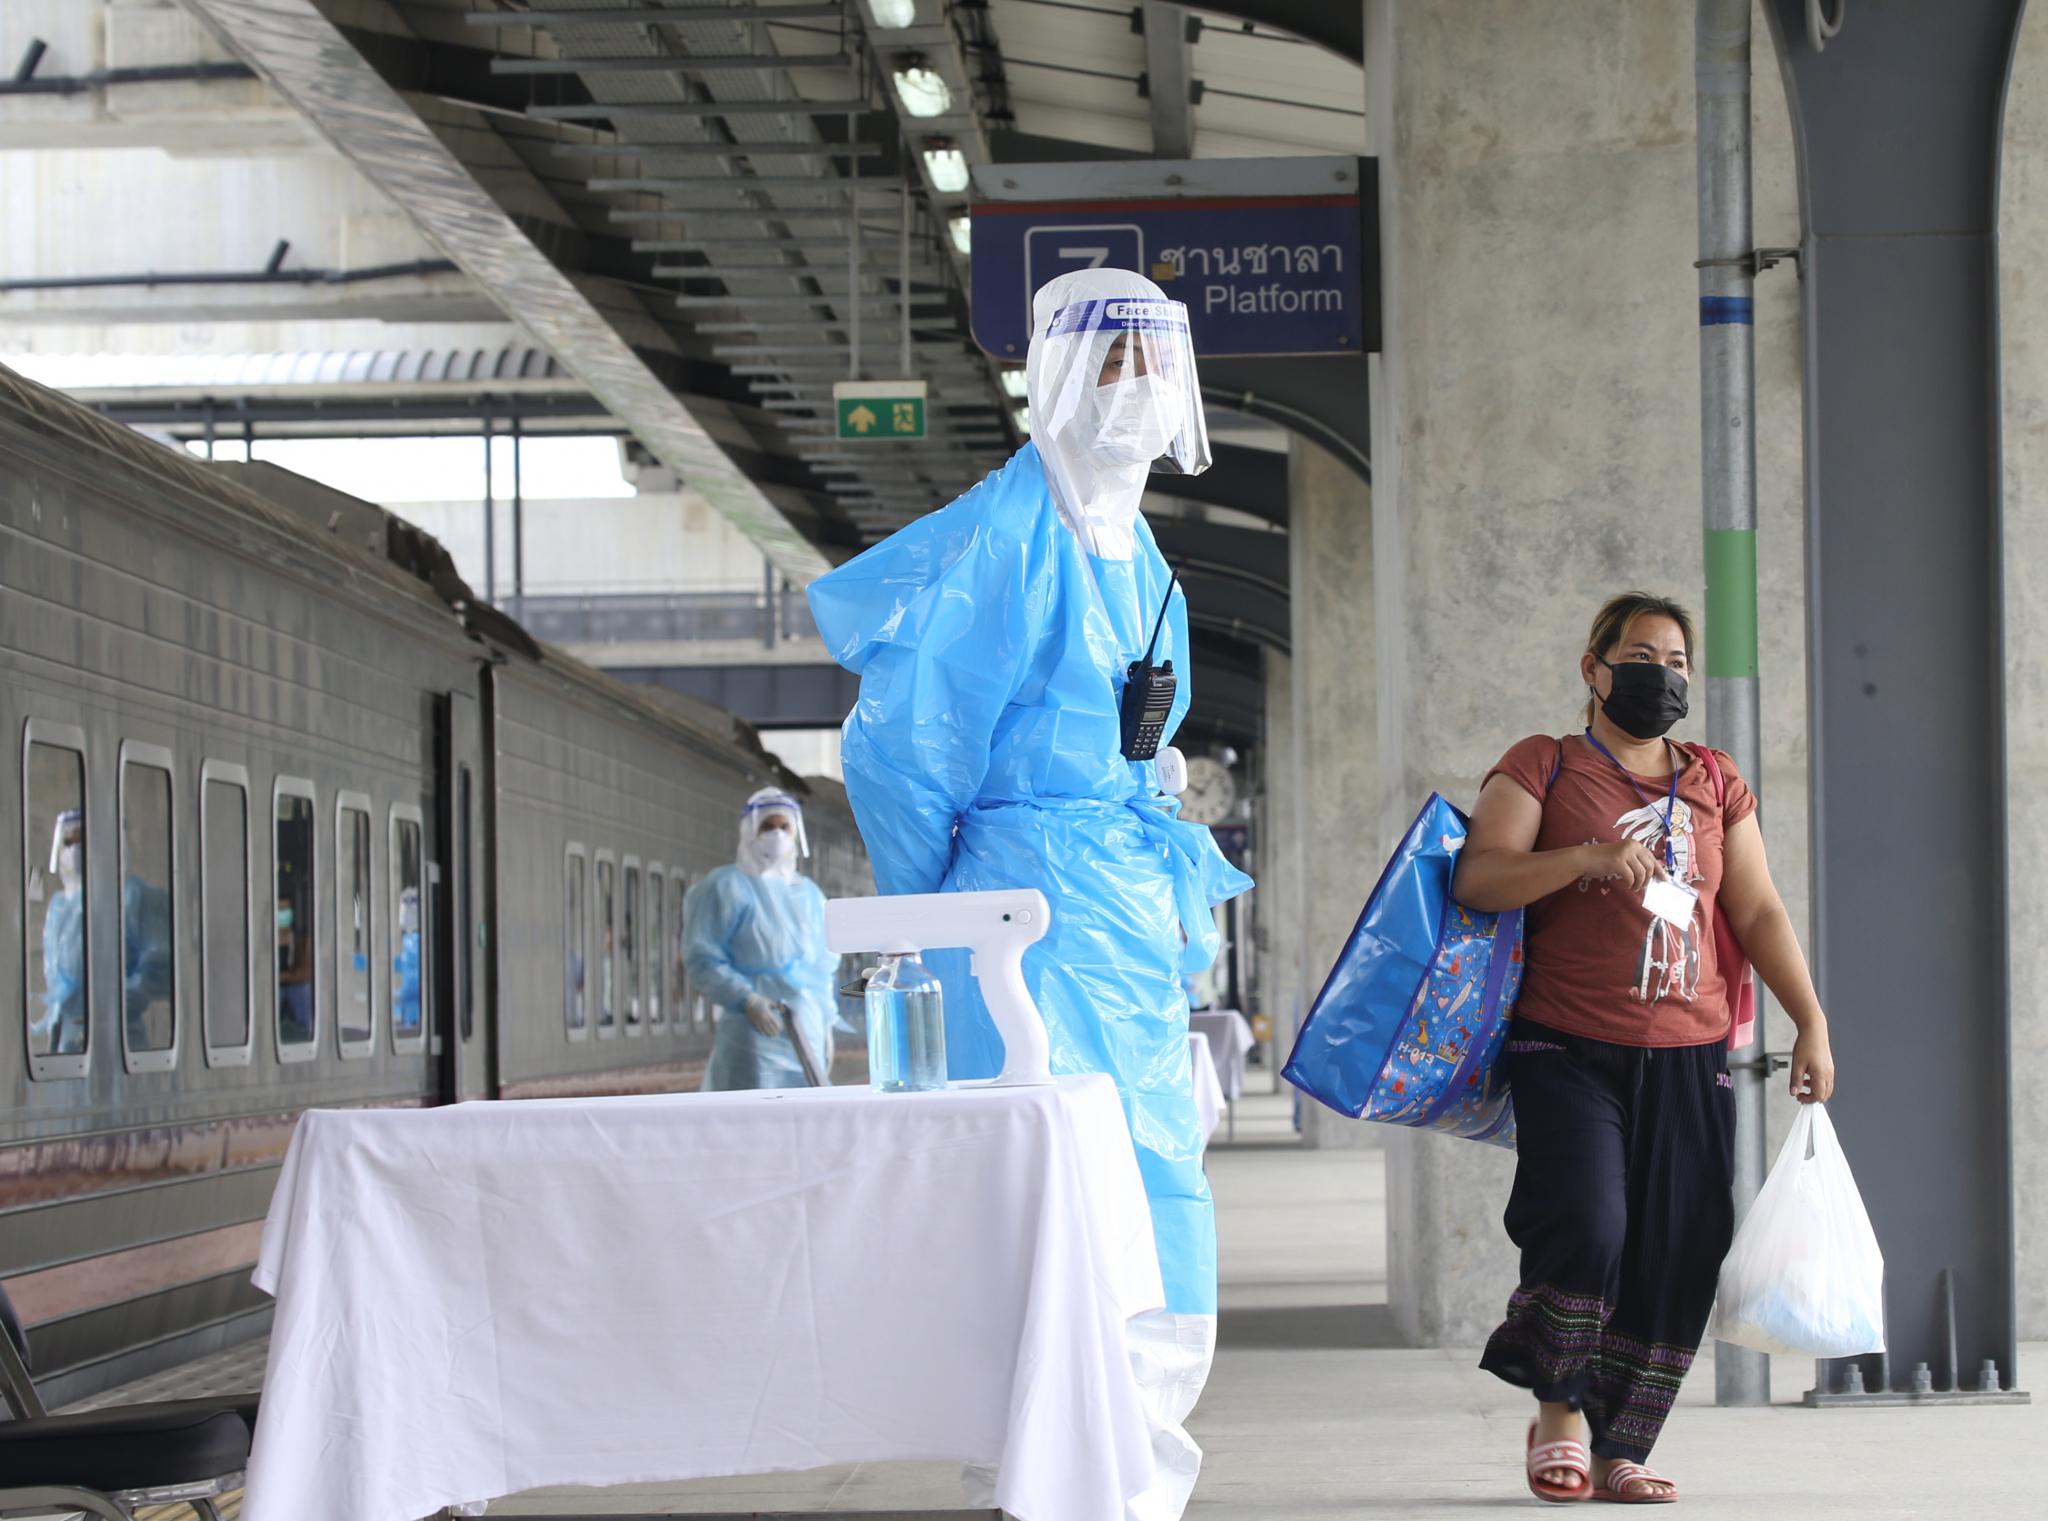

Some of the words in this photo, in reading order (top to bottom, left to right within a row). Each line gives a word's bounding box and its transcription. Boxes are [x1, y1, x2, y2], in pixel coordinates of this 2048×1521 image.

[1159, 243, 1343, 277] ชานชาลา
[1117, 304, 1149, 316] Face
[1205, 283, 1343, 315] Platform
[1398, 1041, 1435, 1065] H-013
